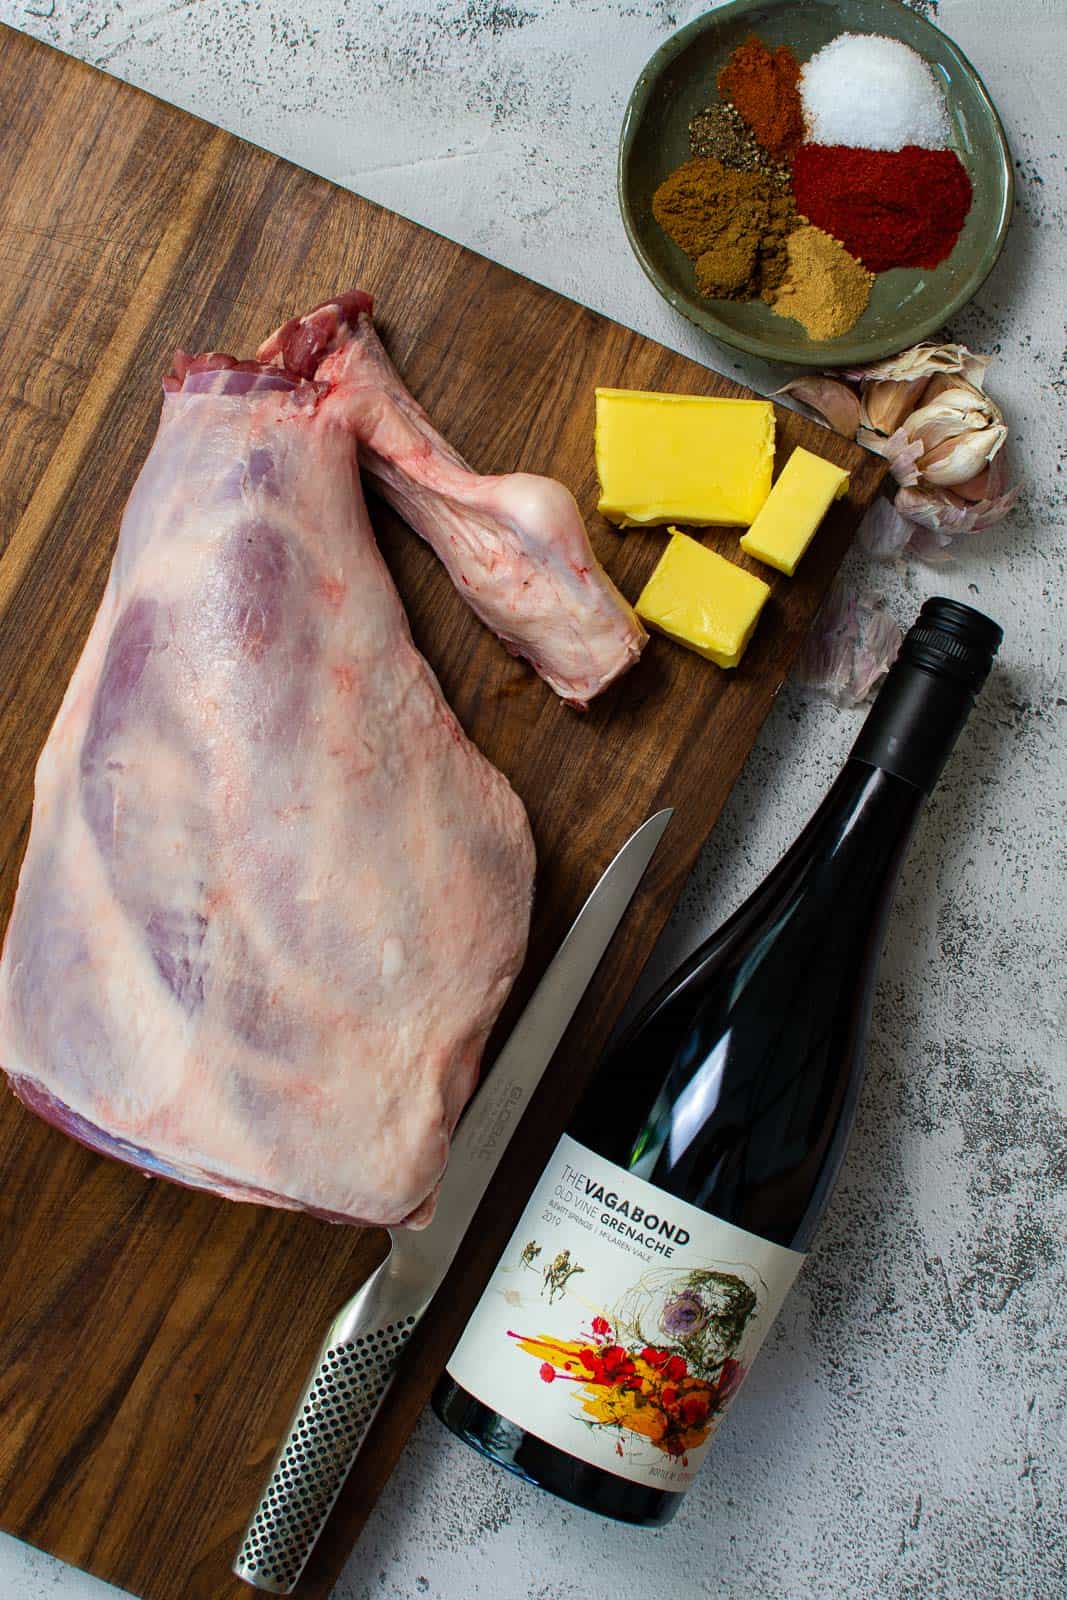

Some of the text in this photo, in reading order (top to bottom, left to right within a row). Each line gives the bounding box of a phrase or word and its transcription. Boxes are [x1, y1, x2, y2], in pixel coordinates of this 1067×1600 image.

[542, 1210, 561, 1226] 2019
[555, 1184, 675, 1259] OLD VINE GRENACHE
